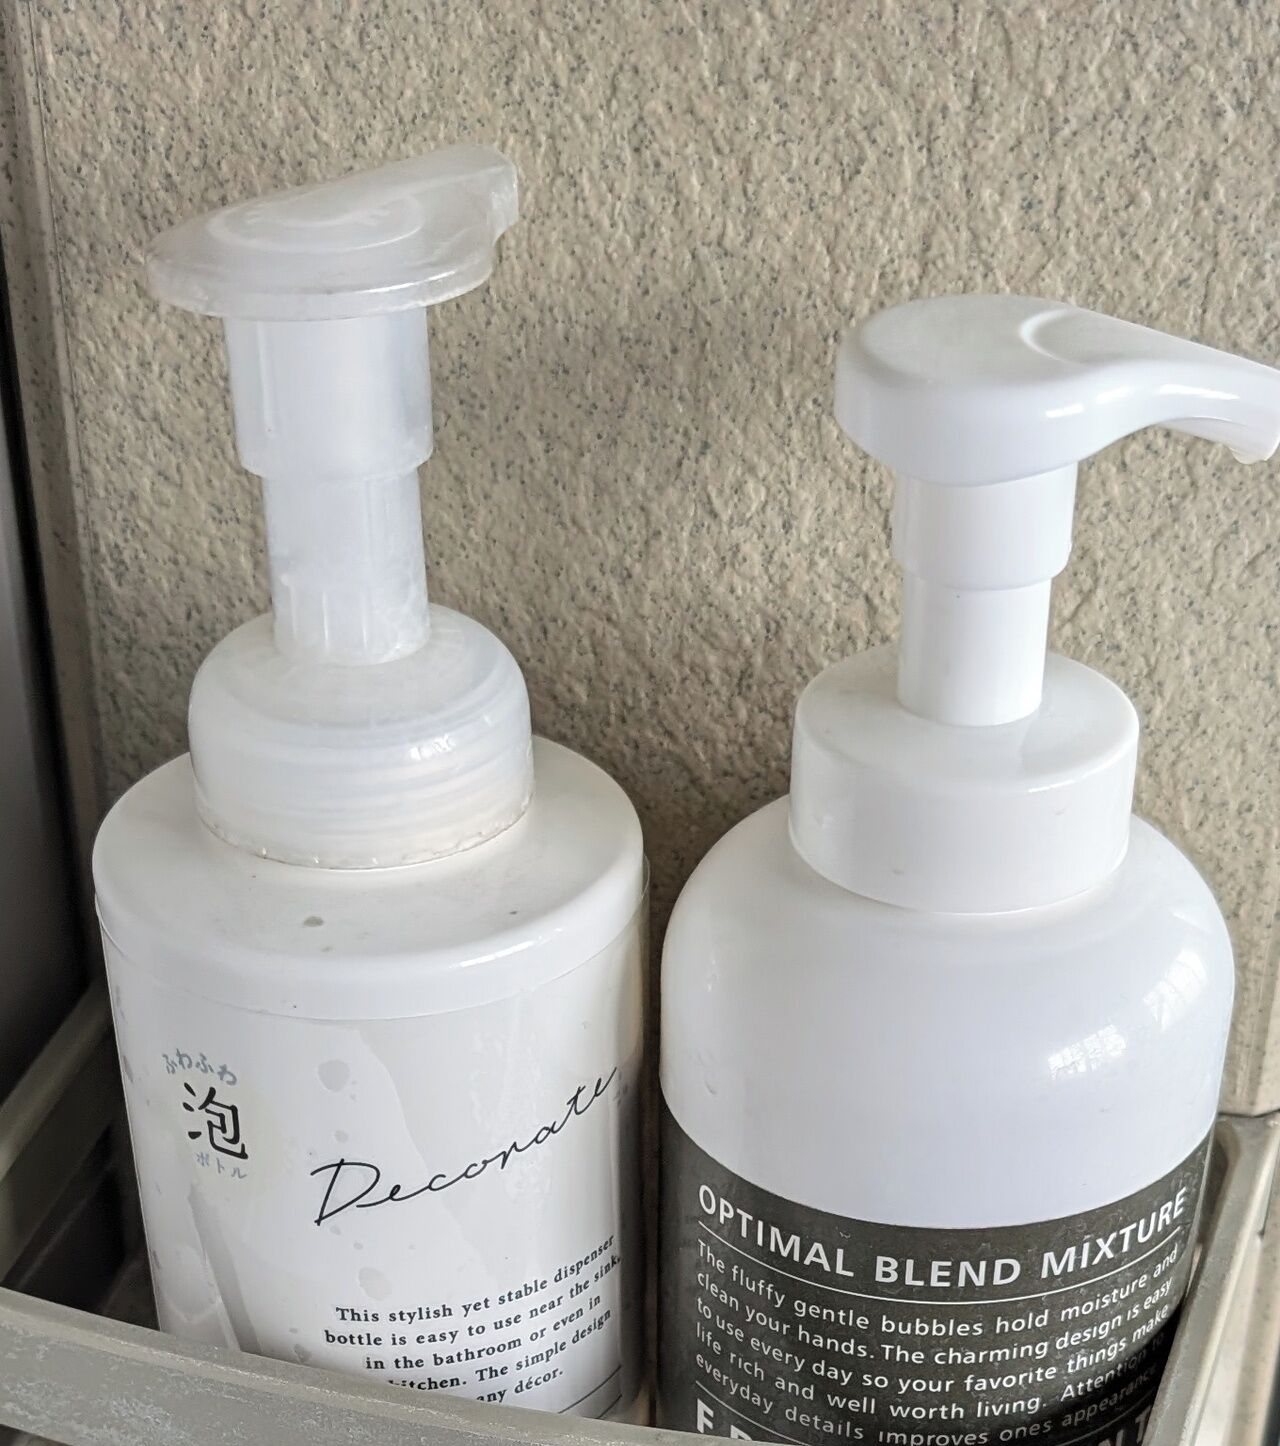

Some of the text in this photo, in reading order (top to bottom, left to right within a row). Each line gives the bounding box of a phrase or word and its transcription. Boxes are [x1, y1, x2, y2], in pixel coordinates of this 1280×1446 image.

[162, 1048, 238, 1086] ふわふわ
[182, 1082, 249, 1160] 泡
[310, 1067, 617, 1226] Decorate
[196, 1152, 248, 1180] ボトル
[335, 1234, 615, 1325] This stylish yet stable dispenser
[698, 1184, 1188, 1288] OPTIMAL BLEND MIXTURE
[324, 1329, 383, 1346] bottle
[391, 1333, 407, 1346] is
[416, 1329, 459, 1344] easy
[467, 1324, 486, 1337] to
[493, 1313, 522, 1331] use
[529, 1294, 564, 1319] near
[569, 1279, 590, 1299] the
[366, 1294, 601, 1370] in the bathroom or even in
[697, 1272, 1173, 1365] clean your hands. The charming design is easy
[698, 1238, 1178, 1337] The fluffy gentle bubbles hold moisture and
[475, 1365, 509, 1383] The
[515, 1340, 567, 1371] simple
[572, 1308, 612, 1345] design
[514, 1366, 564, 1395] décor.
[696, 1321, 721, 1355] life
[729, 1351, 765, 1382] rich
[775, 1376, 815, 1401] and
[827, 1393, 876, 1415] well
[889, 1402, 965, 1421] worth
[976, 1396, 1048, 1418] living.
[1060, 1348, 1147, 1402] Attention
[697, 1297, 1169, 1395] to use every day so your favorite things make
[696, 1353, 774, 1414] everyday
[784, 1406, 864, 1441] details
[999, 1419, 1052, 1442] ones
